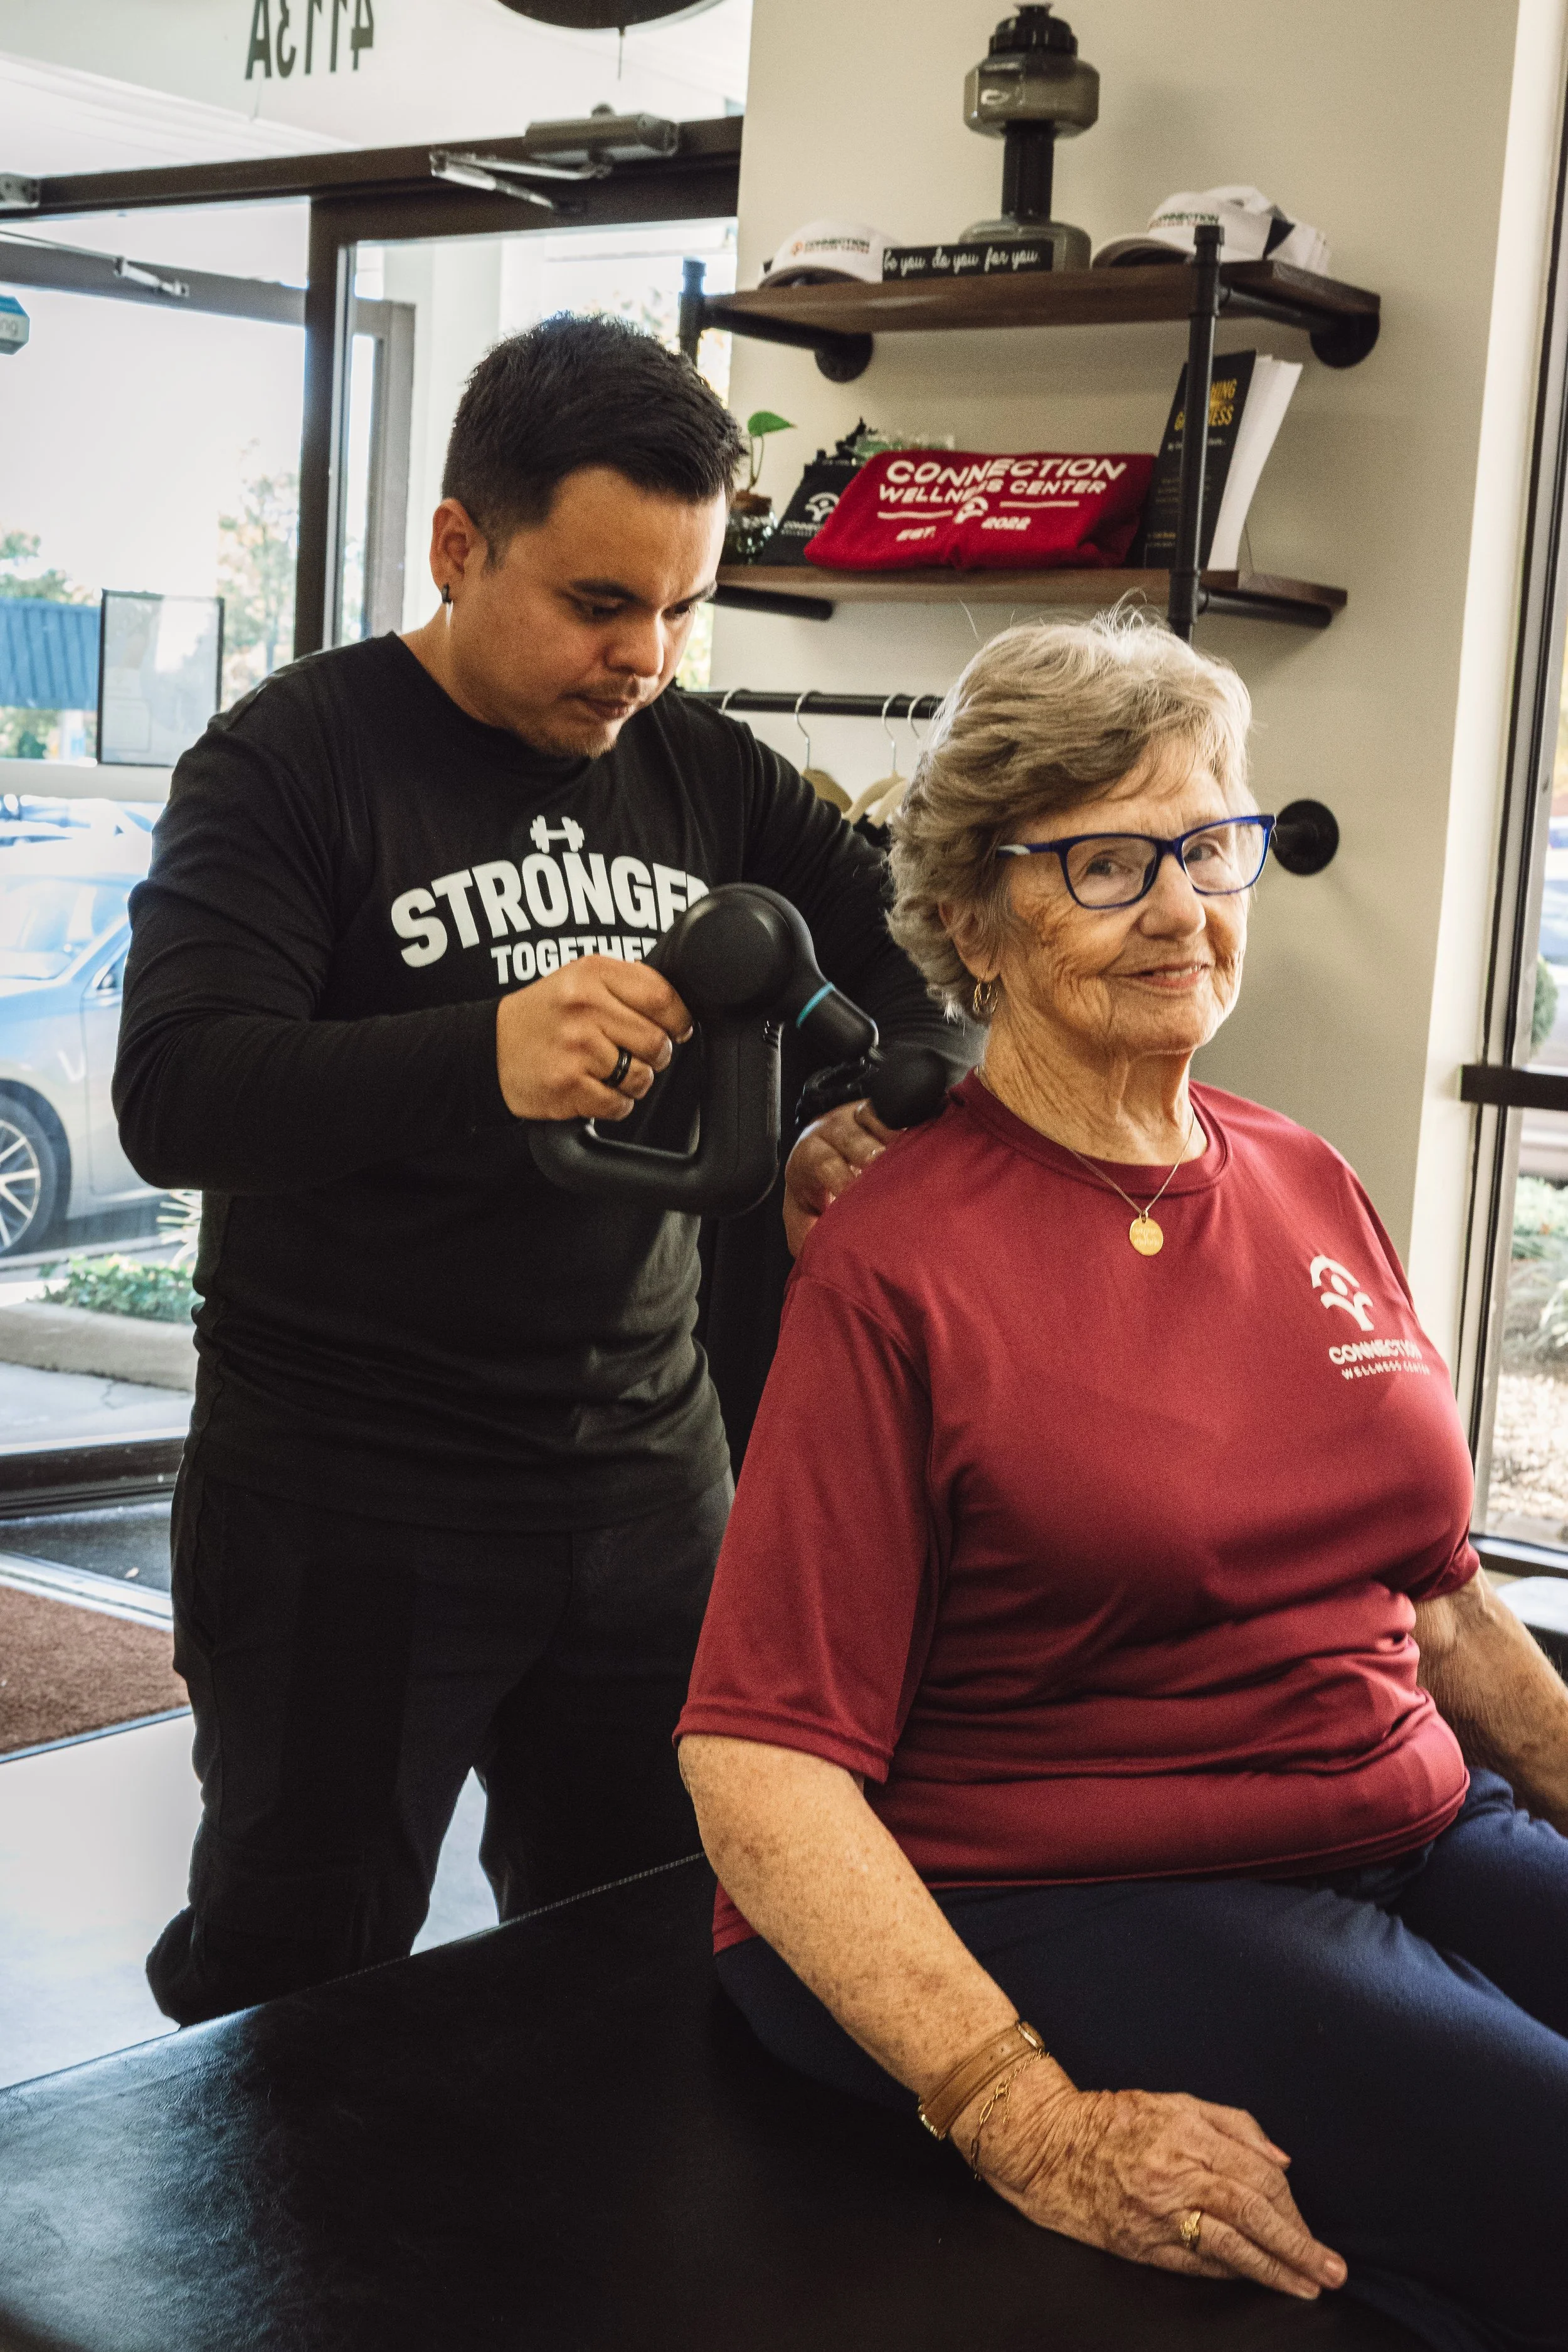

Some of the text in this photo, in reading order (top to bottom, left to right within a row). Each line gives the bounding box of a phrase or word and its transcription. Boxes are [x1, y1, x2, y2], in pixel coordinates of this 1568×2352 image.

[886, 458, 1127, 487] CONNECTION
[1009, 479, 1107, 495] CENTER
[980, 516, 1032, 531] 2022
[1341, 1360, 1402, 1380] WELLNESS
